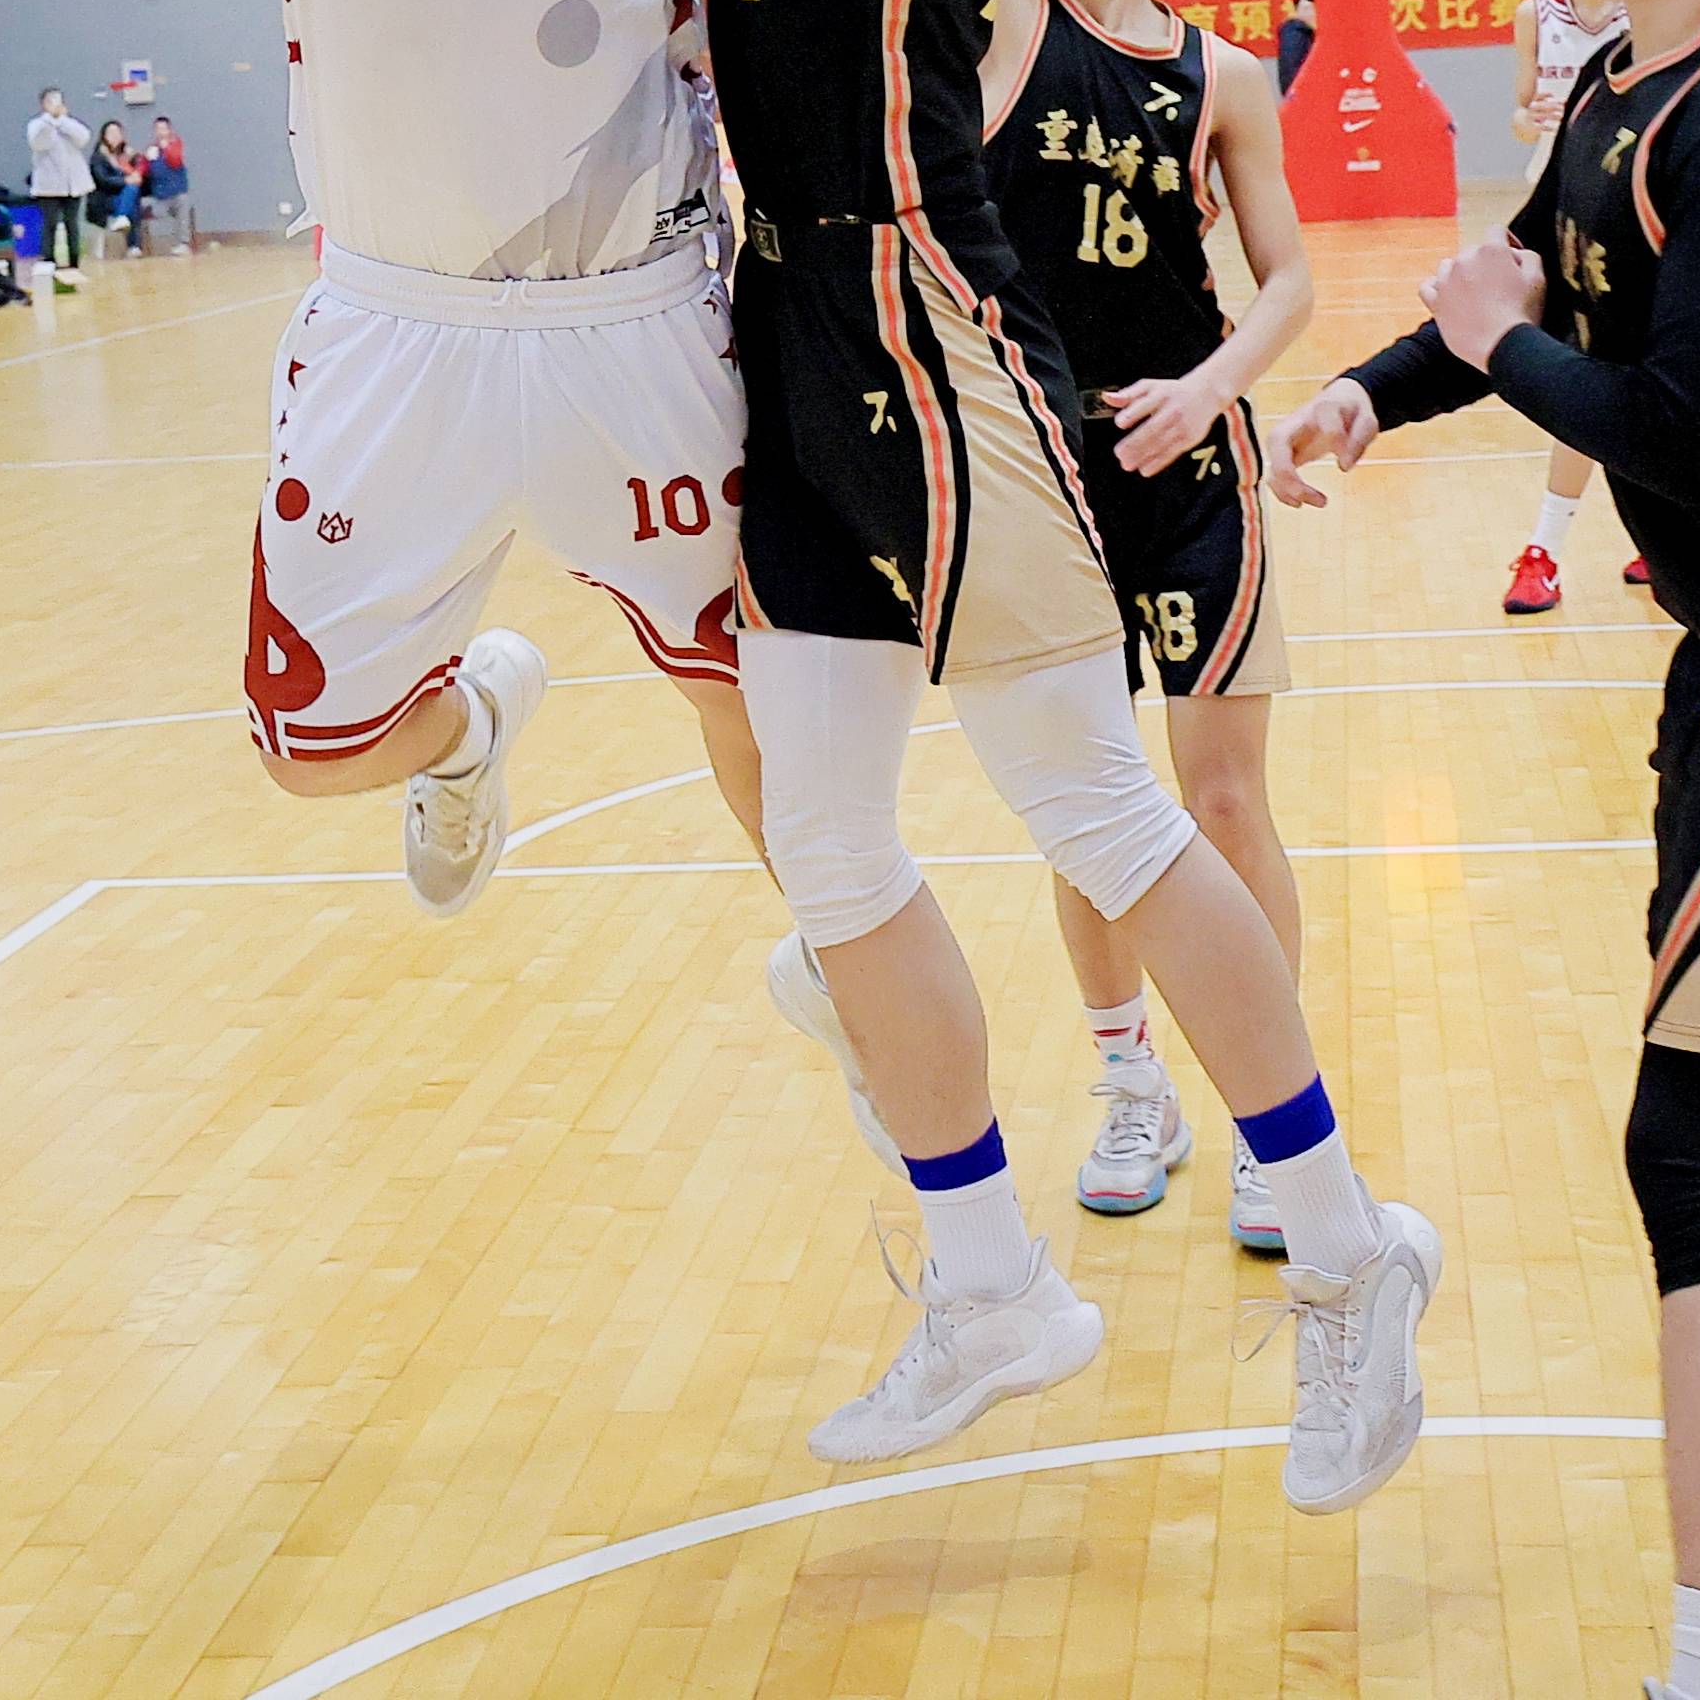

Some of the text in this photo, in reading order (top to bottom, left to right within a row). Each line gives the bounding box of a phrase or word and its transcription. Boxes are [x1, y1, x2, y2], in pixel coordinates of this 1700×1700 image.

[1179, 0, 1298, 42] 育预
[1077, 183, 1149, 268] 18
[627, 474, 711, 542] 10
